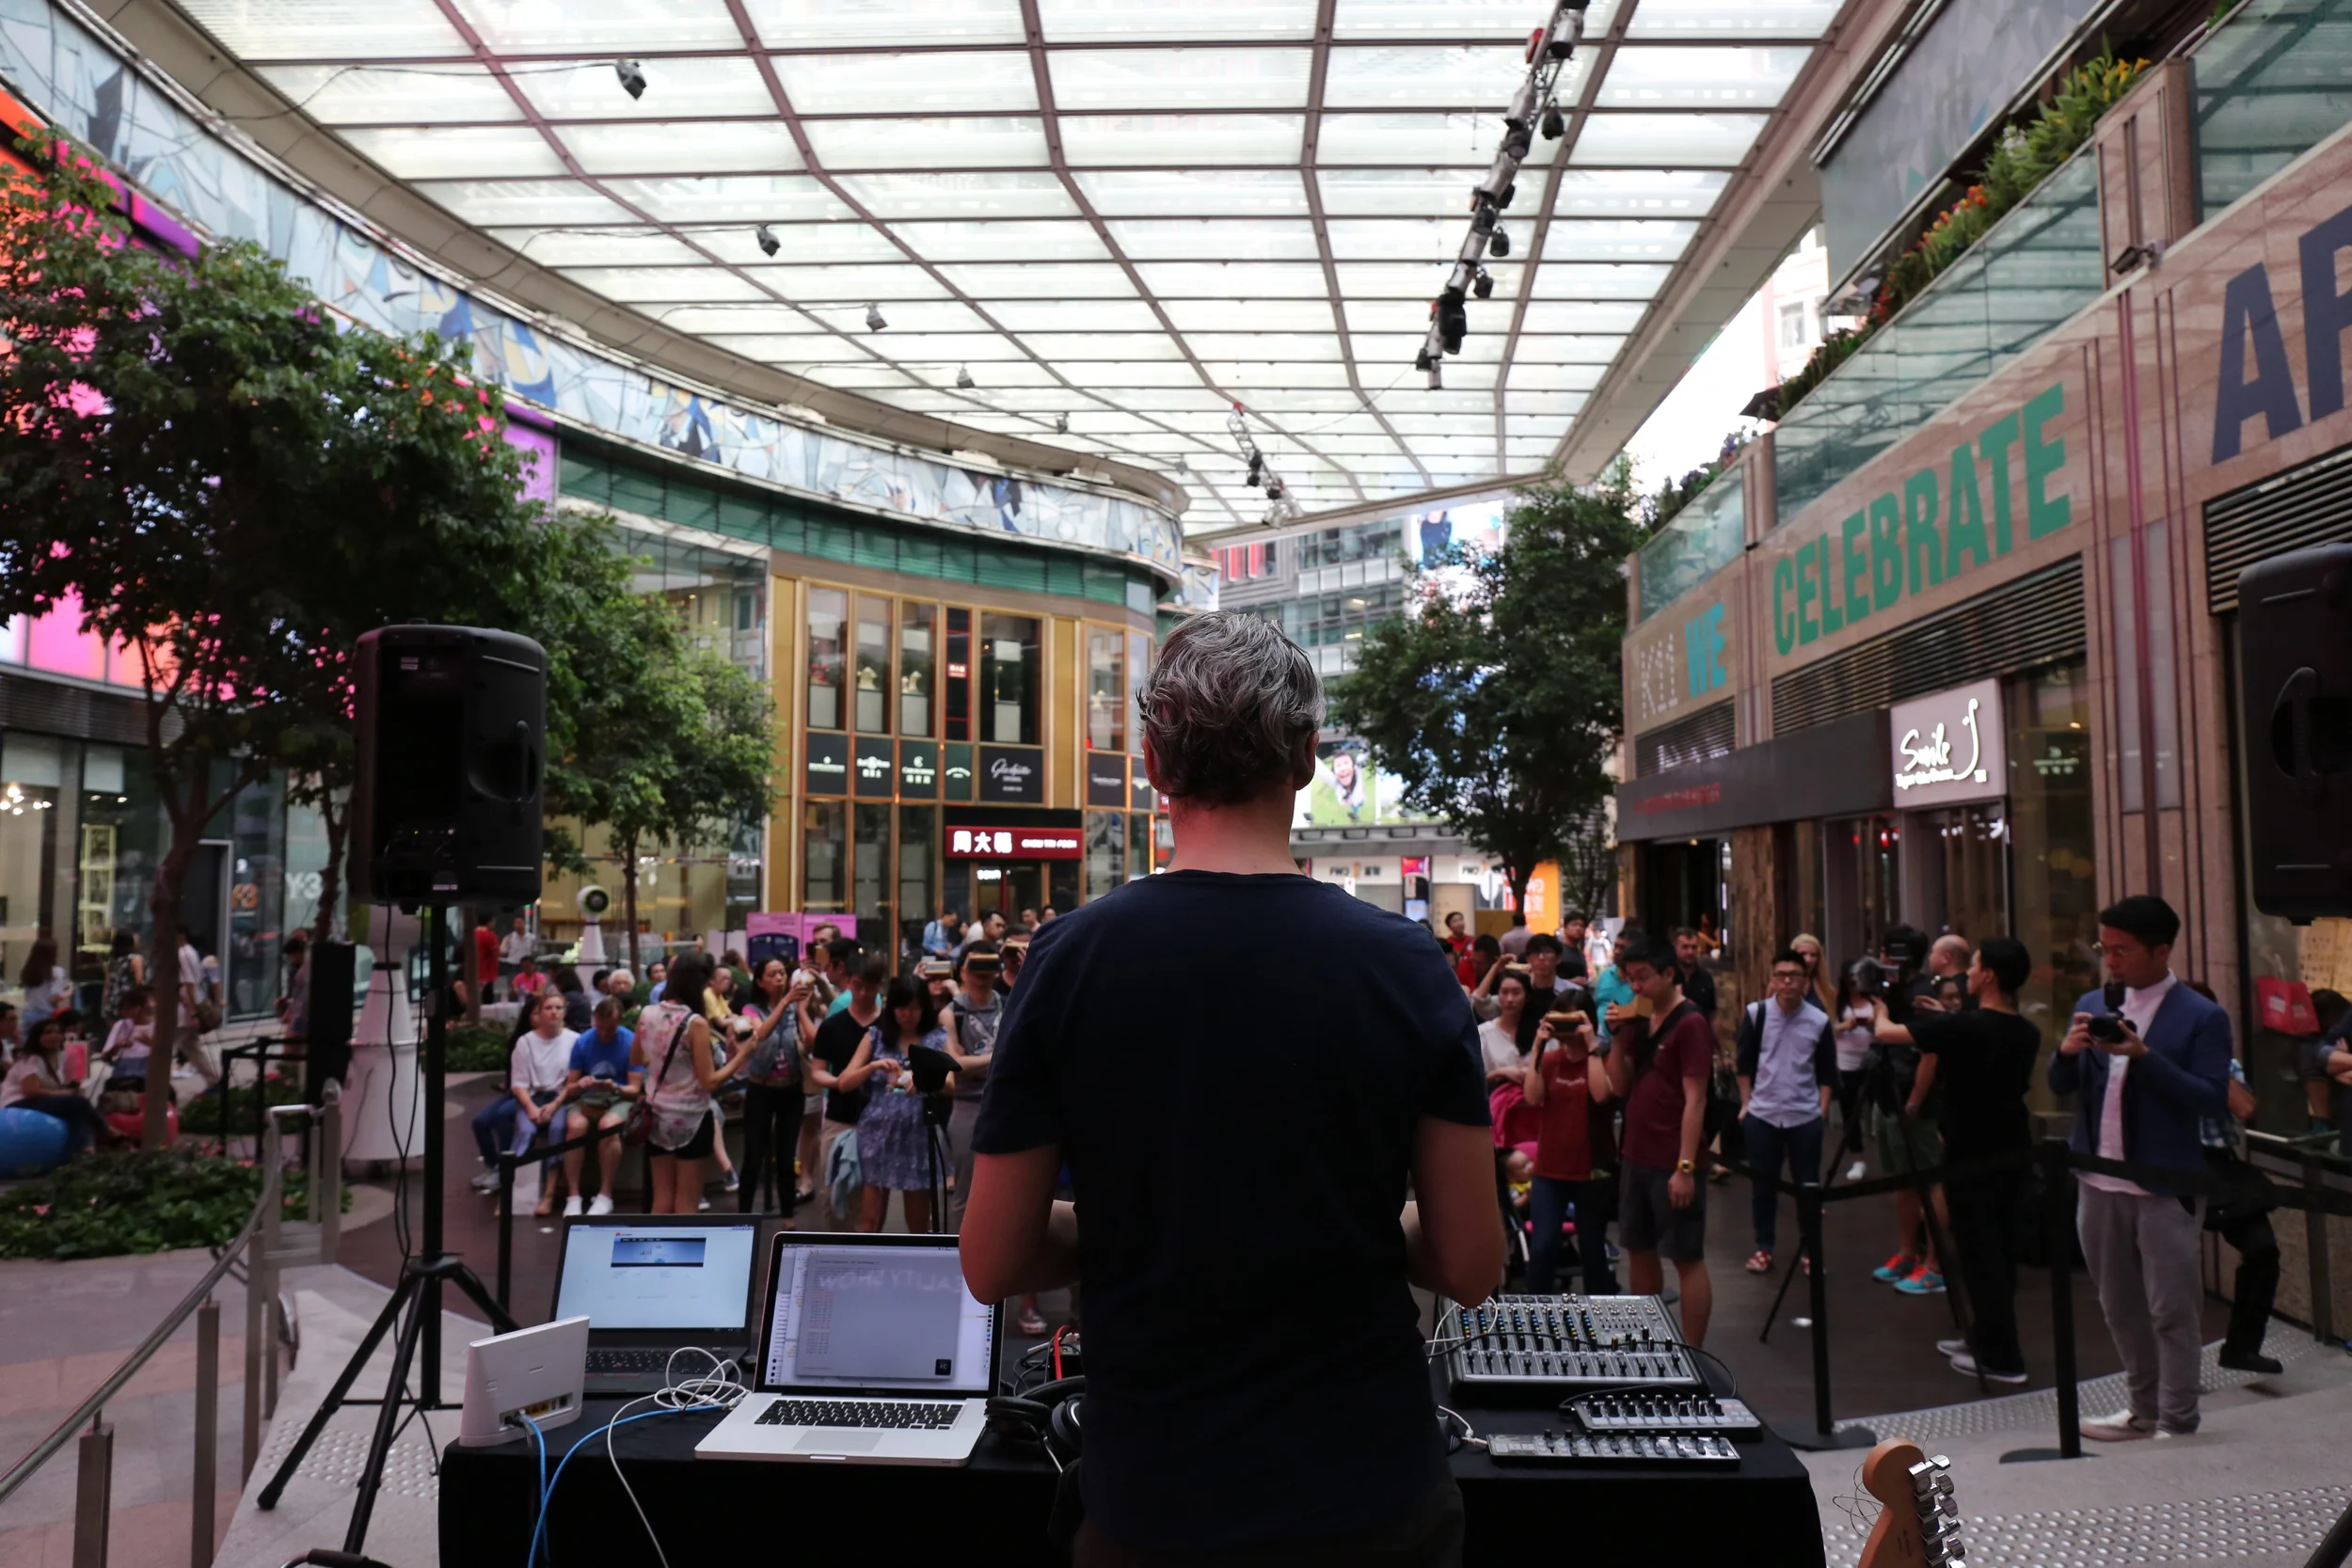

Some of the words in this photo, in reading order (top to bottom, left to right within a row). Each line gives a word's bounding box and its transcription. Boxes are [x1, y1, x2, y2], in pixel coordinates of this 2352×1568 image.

[1641, 632, 1678, 720] K11
[1685, 602, 1726, 699] WE
[1773, 380, 2073, 657] CELEBRATE
[1899, 722, 1950, 771] Smile
